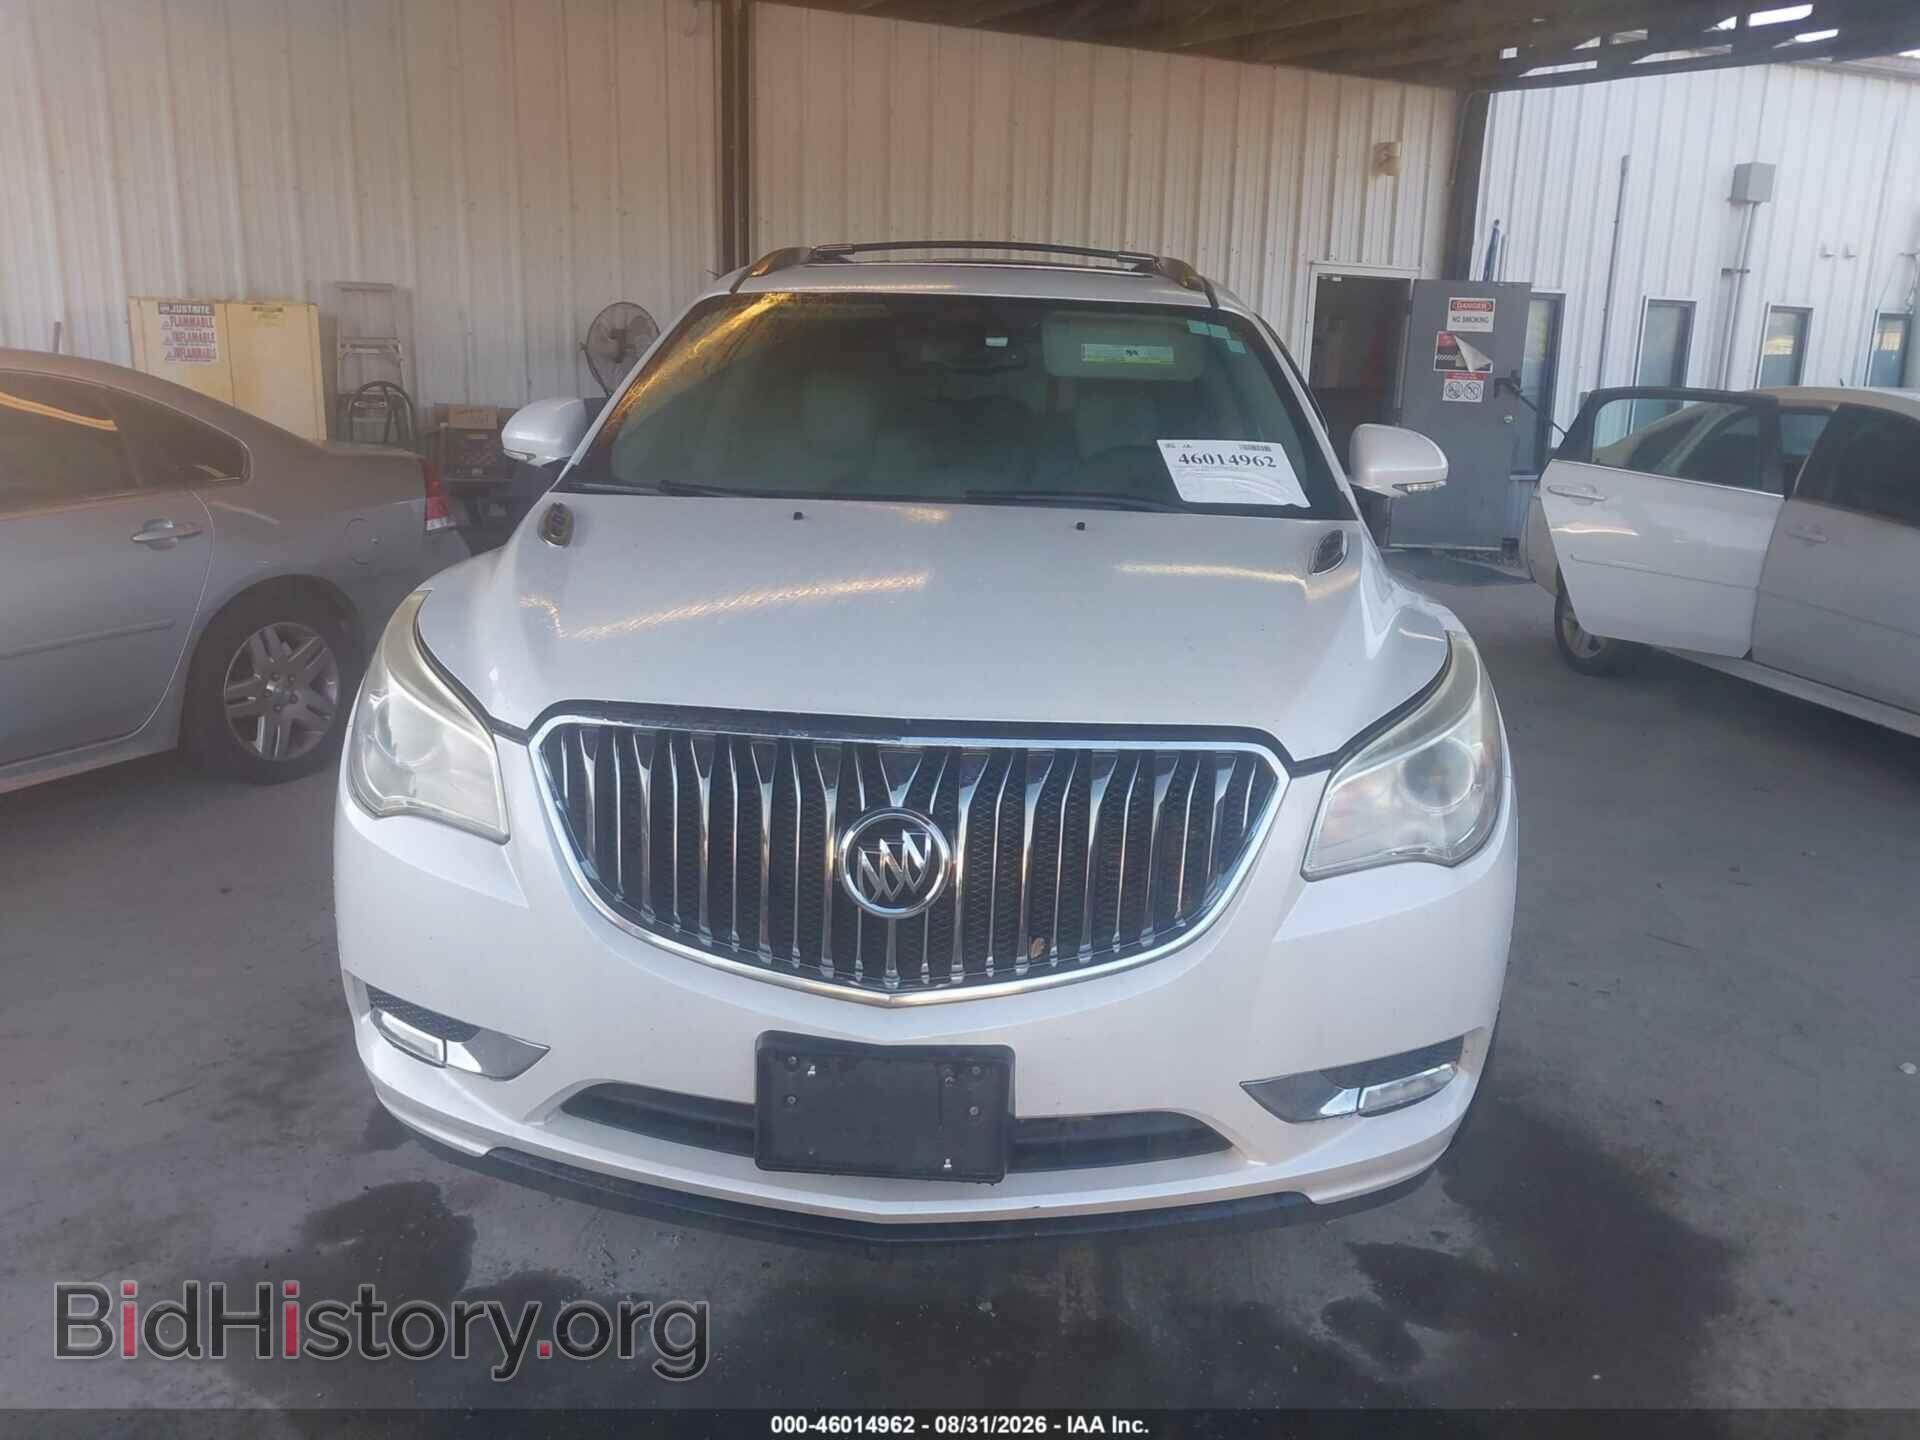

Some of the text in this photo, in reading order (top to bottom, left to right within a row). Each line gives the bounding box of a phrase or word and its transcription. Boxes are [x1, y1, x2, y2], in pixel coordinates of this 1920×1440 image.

[1456, 302, 1487, 310] DANGER
[169, 316, 214, 328] FLAMMABLE
[1178, 453, 1277, 468] 46014962
